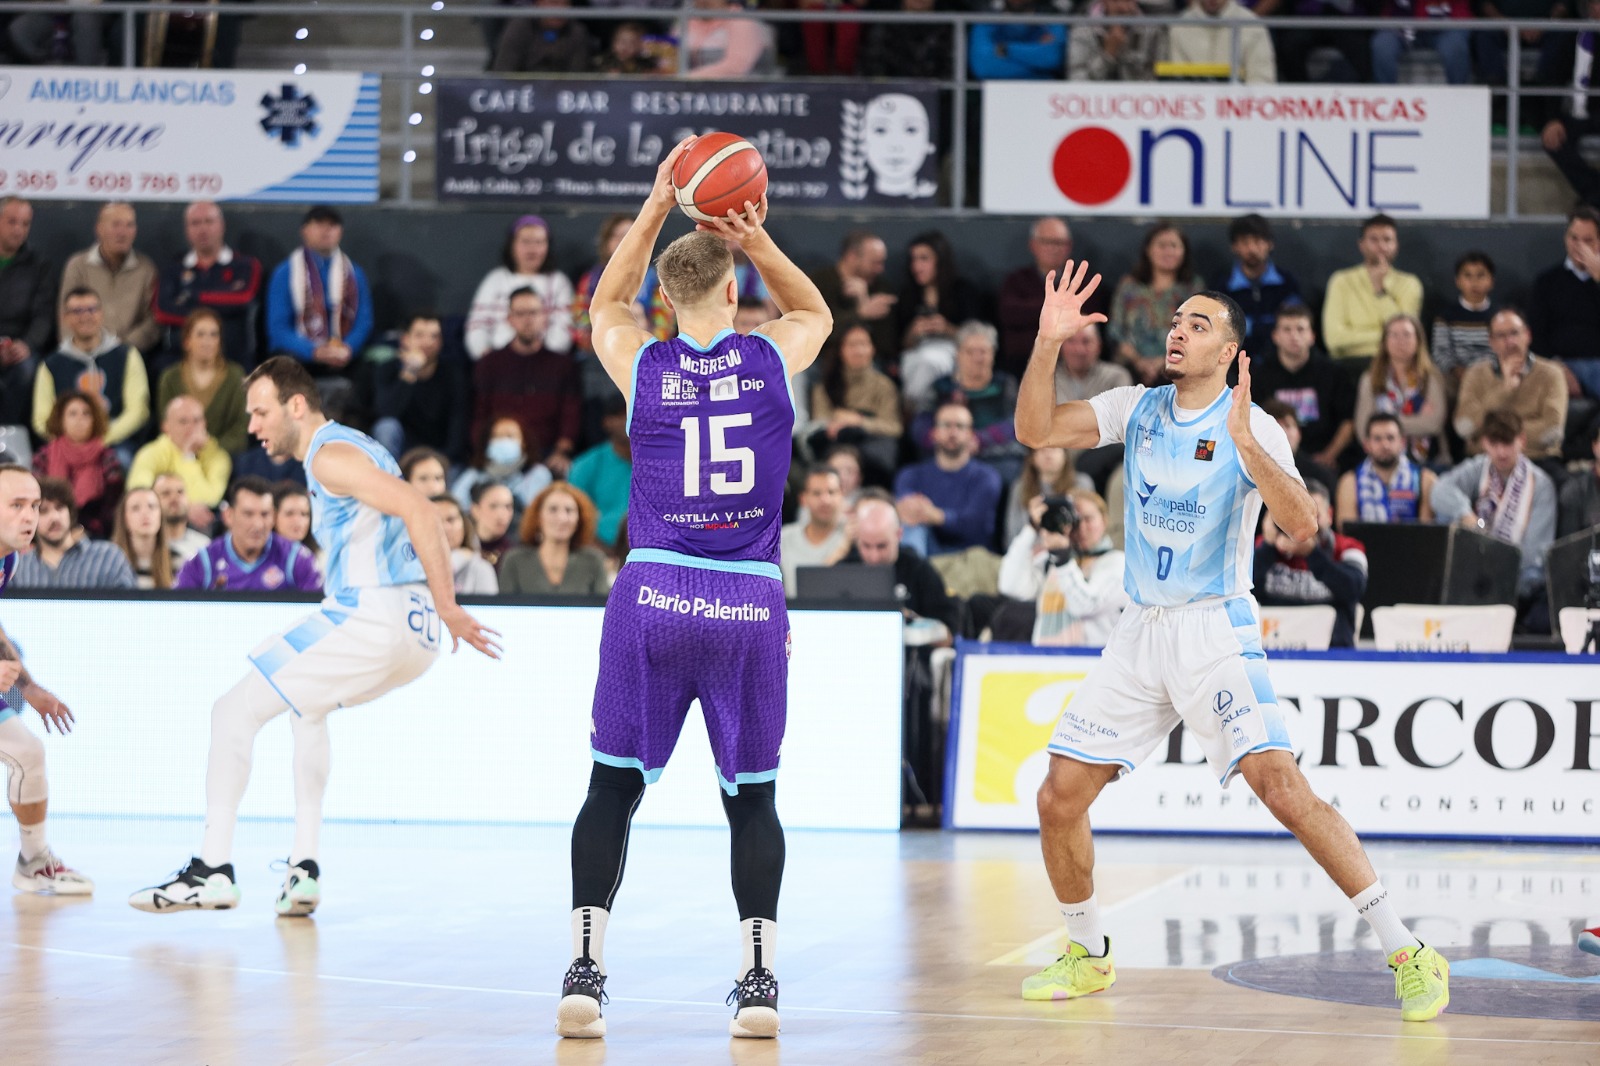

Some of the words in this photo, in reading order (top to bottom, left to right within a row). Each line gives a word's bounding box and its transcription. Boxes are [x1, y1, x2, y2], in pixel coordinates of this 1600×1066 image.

[470, 84, 535, 113] CAFÉ
[557, 91, 609, 114] BAR
[632, 91, 810, 116] RESTAURANTE
[1049, 93, 1205, 119] SOLUCIONES
[1216, 90, 1427, 122] INFORMÁTICAS
[0, 106, 165, 172] nrique
[443, 117, 558, 173] Trigal
[567, 121, 616, 165] de
[628, 122, 662, 165] la
[681, 392, 697, 400] CIA
[682, 379, 694, 387] PA
[741, 378, 765, 392] Dip
[680, 412, 755, 497] 15
[663, 513, 719, 523] CASTILLA
[725, 512, 733, 522] Y
[738, 506, 764, 519] LEÓN
[1143, 512, 1195, 534] BURGOS
[1157, 546, 1173, 581] 0
[637, 585, 691, 614] Diario
[693, 597, 770, 621] Palentino
